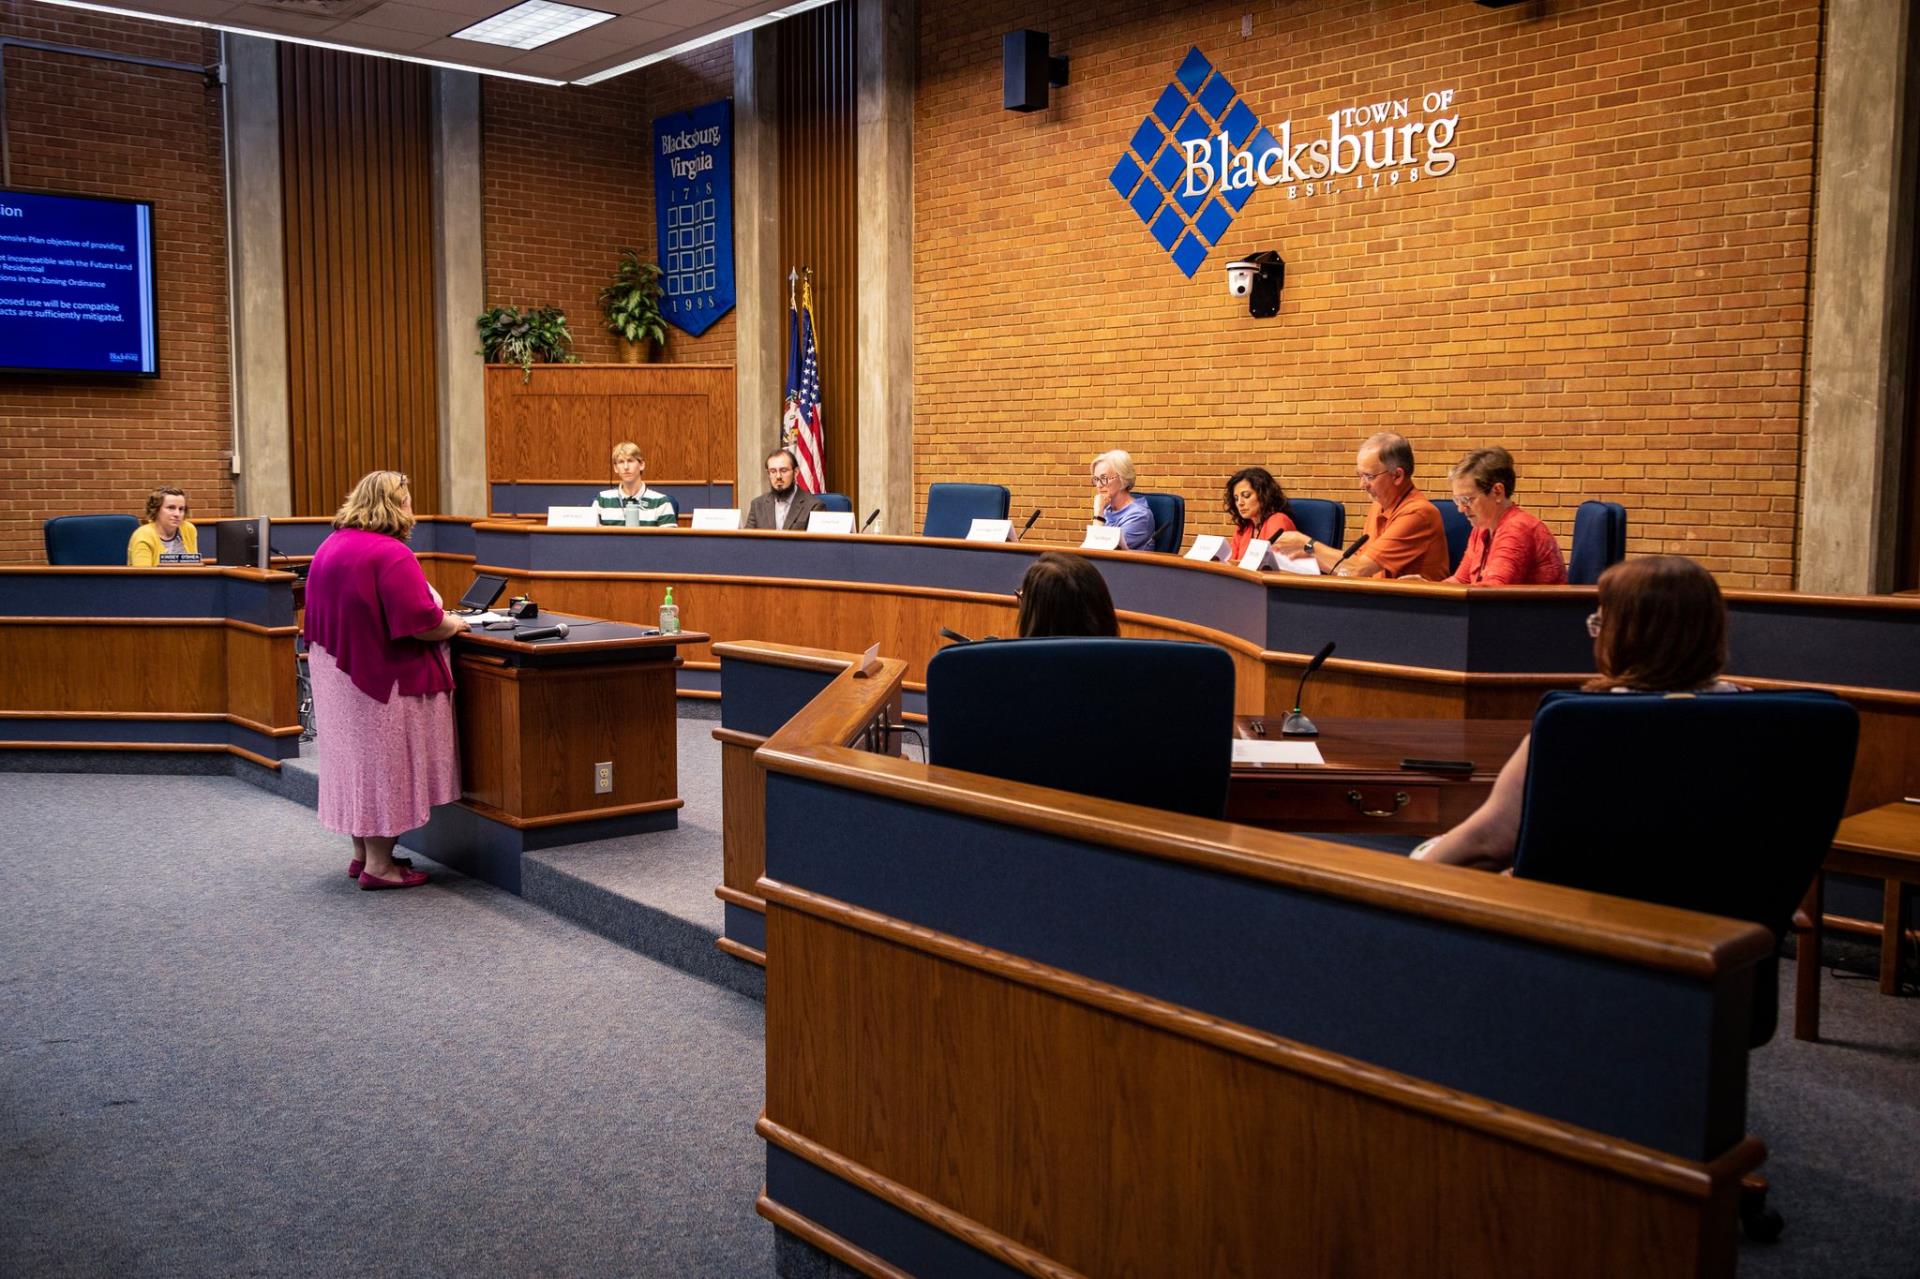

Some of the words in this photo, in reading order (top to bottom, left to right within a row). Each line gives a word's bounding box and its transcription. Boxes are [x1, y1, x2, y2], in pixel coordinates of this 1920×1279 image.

[1341, 98, 1409, 128] TOWN
[1423, 89, 1454, 113] OF
[1182, 110, 1460, 198] Blacksburg
[671, 182, 712, 203] 178
[1287, 181, 1341, 200] EST.
[1356, 169, 1419, 190] 1798
[0, 204, 23, 217] ion
[28, 236, 45, 244] Plan
[46, 238, 80, 247] objective
[91, 242, 125, 252] providing
[2, 264, 45, 273] Residential
[7, 255, 56, 265] incompatible
[58, 258, 75, 267] with
[76, 259, 89, 268] the
[90, 261, 114, 269] Future
[115, 262, 133, 271] Land
[18, 274, 26, 283] in
[27, 276, 40, 284] the
[41, 276, 67, 287] Zoning
[68, 278, 106, 288] Ordinance
[43, 299, 59, 308] will
[60, 300, 71, 309] be
[73, 302, 120, 312] compatible
[672, 295, 714, 313] 1998
[19, 309, 33, 317] are
[35, 310, 81, 321] sufficiently
[82, 312, 124, 322] mitigated.
